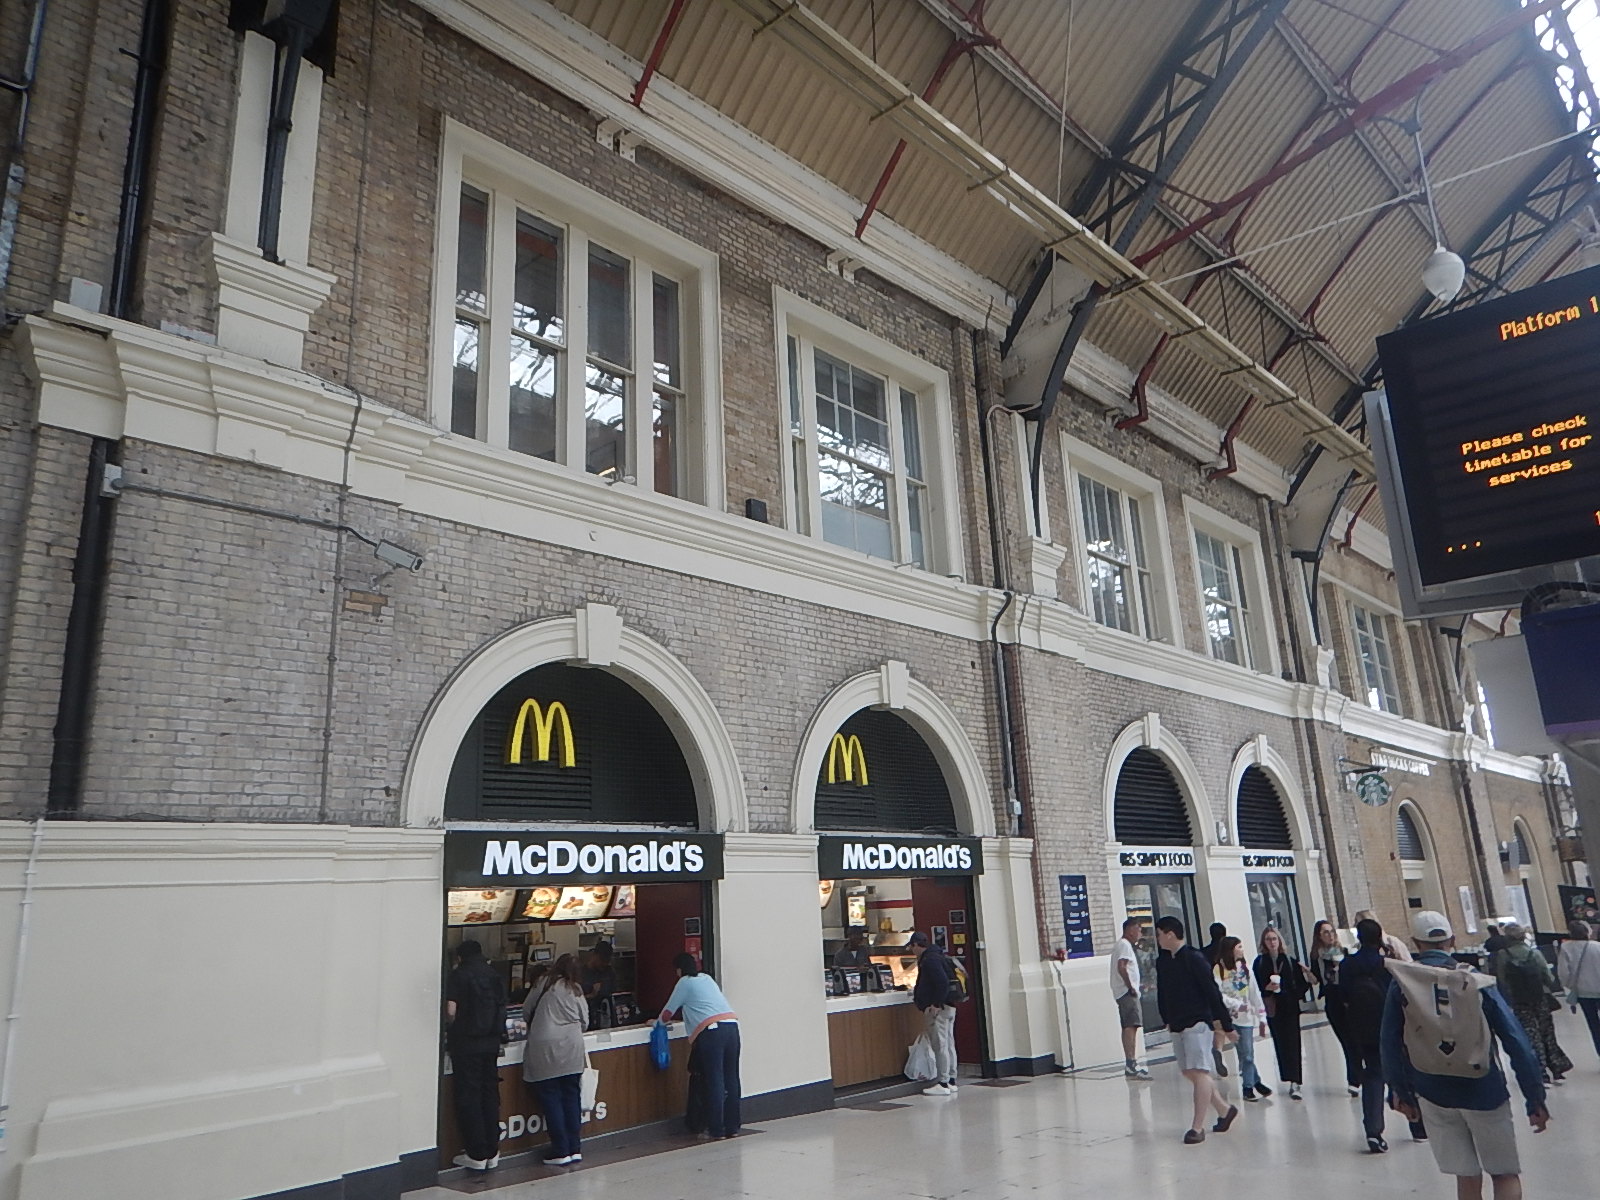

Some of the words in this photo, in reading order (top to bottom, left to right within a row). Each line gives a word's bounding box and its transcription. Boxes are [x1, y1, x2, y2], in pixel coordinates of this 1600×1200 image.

[1500, 305, 1581, 341] Platform
[1461, 432, 1524, 456] Please
[1531, 414, 1588, 438] check
[1464, 444, 1553, 473] timetable
[1559, 434, 1593, 451] for
[1488, 459, 1573, 487] services
[482, 839, 704, 876] McDonald's
[842, 843, 972, 870] McDonald's
